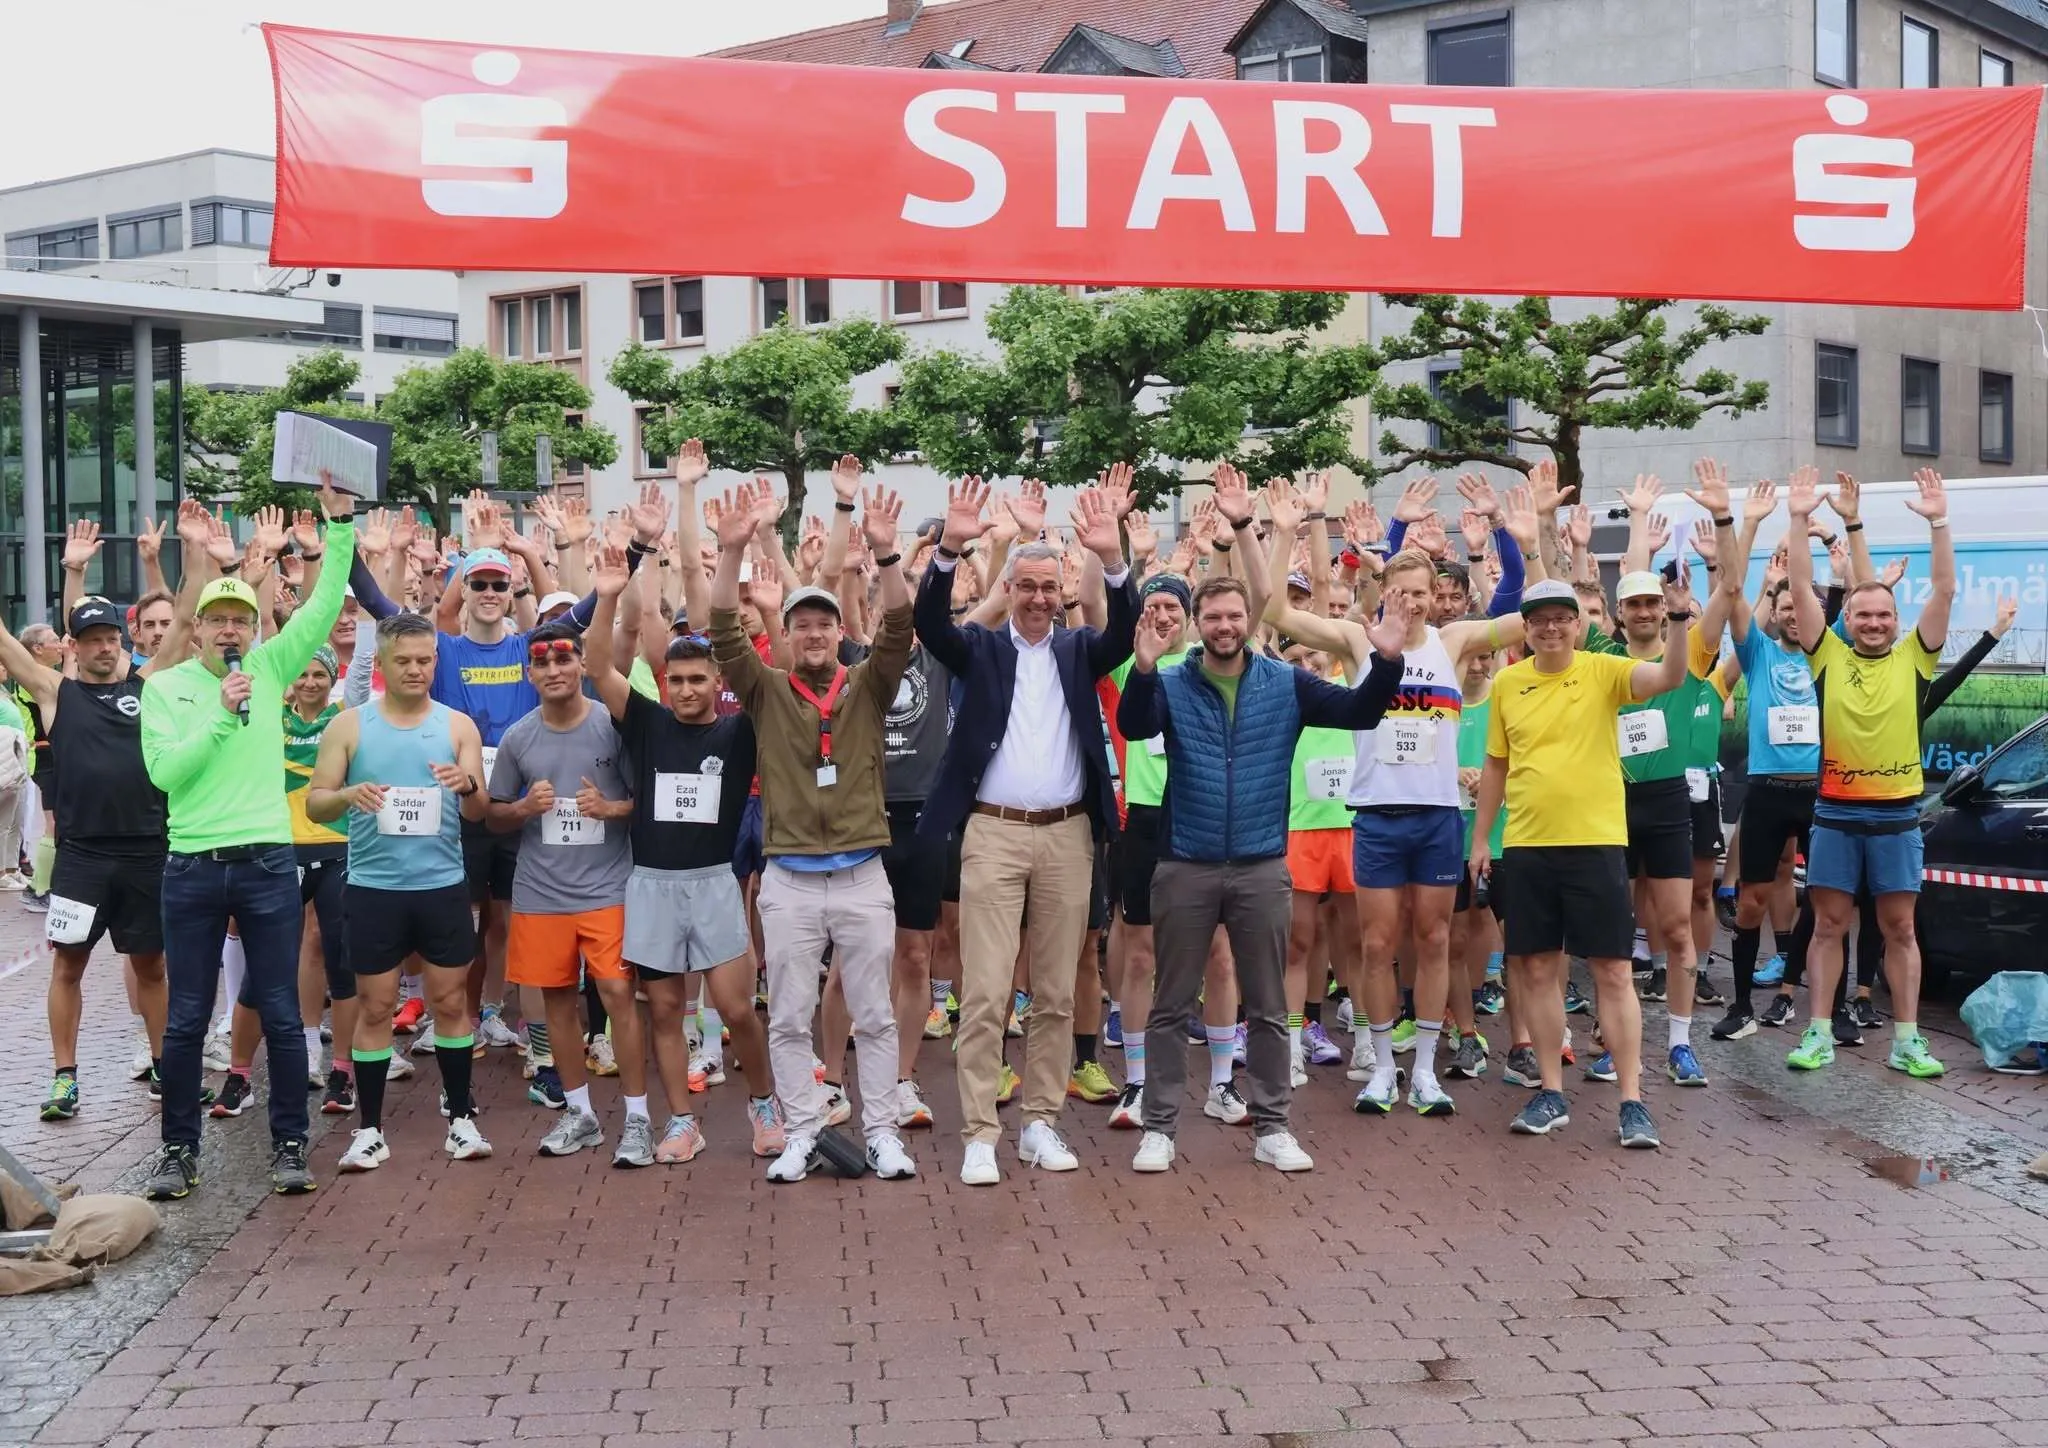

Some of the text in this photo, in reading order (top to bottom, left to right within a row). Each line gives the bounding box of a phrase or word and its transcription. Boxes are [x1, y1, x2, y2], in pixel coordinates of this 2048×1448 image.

[900, 88, 1498, 239] START
[1625, 722, 1647, 732] Leon
[1786, 724, 1803, 733] 258
[1396, 730, 1418, 739] Timo
[1628, 732, 1647, 743] 505
[1396, 741, 1416, 751] 533
[1321, 768, 1347, 776] Jonas
[1824, 759, 1920, 785] Freigericht
[1329, 778, 1340, 787] 31
[676, 785, 698, 794] Ezat
[393, 798, 426, 807] Safdar
[676, 797, 696, 808] 693
[399, 810, 419, 821] 701
[556, 808, 583, 817] Afsh
[562, 821, 581, 831] 711
[51, 918, 68, 930] 431
